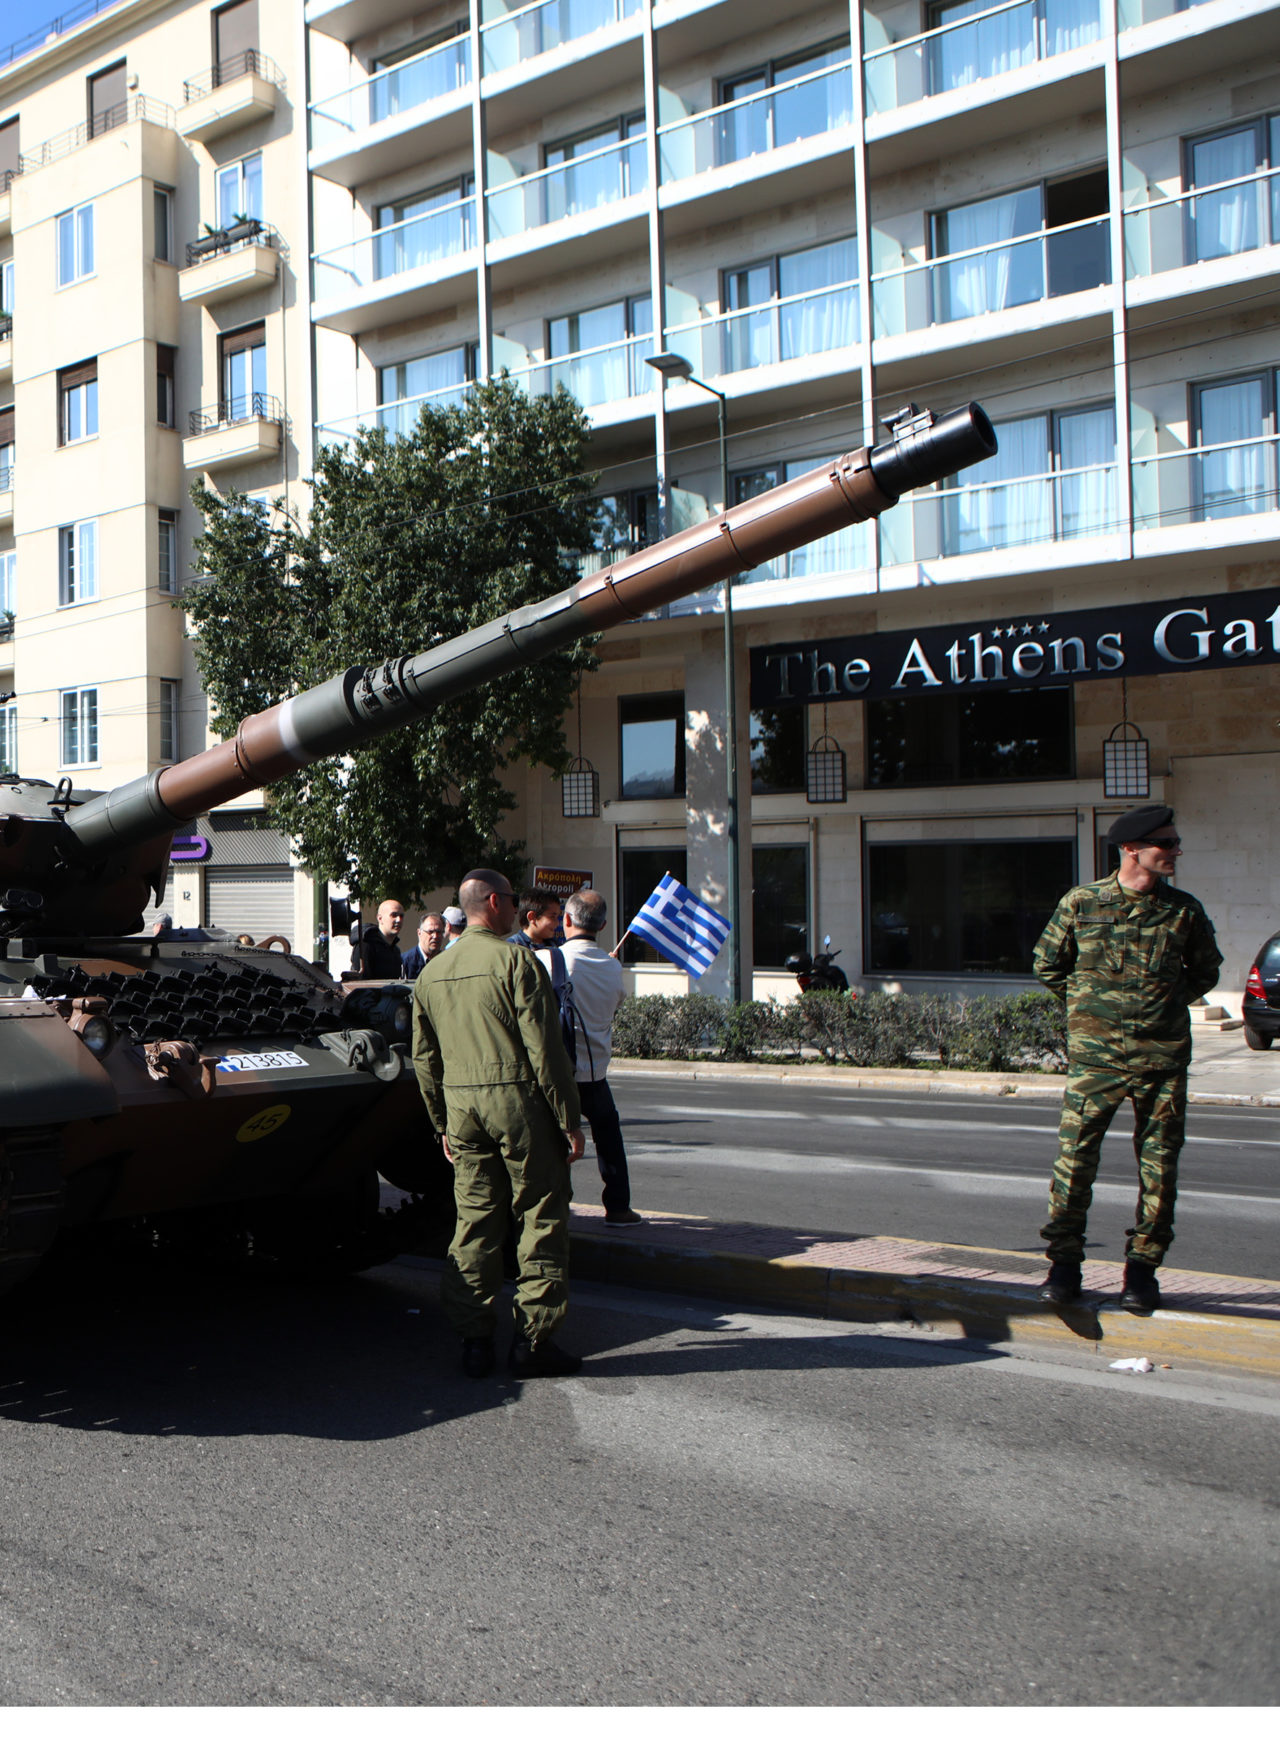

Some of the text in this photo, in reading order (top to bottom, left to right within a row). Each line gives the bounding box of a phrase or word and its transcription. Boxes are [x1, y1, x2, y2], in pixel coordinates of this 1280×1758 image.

[765, 649, 871, 698] The
[890, 631, 1125, 689] Athens
[183, 891, 192, 901] 12
[230, 1052, 303, 1069] 213815
[248, 1113, 284, 1132] 45
